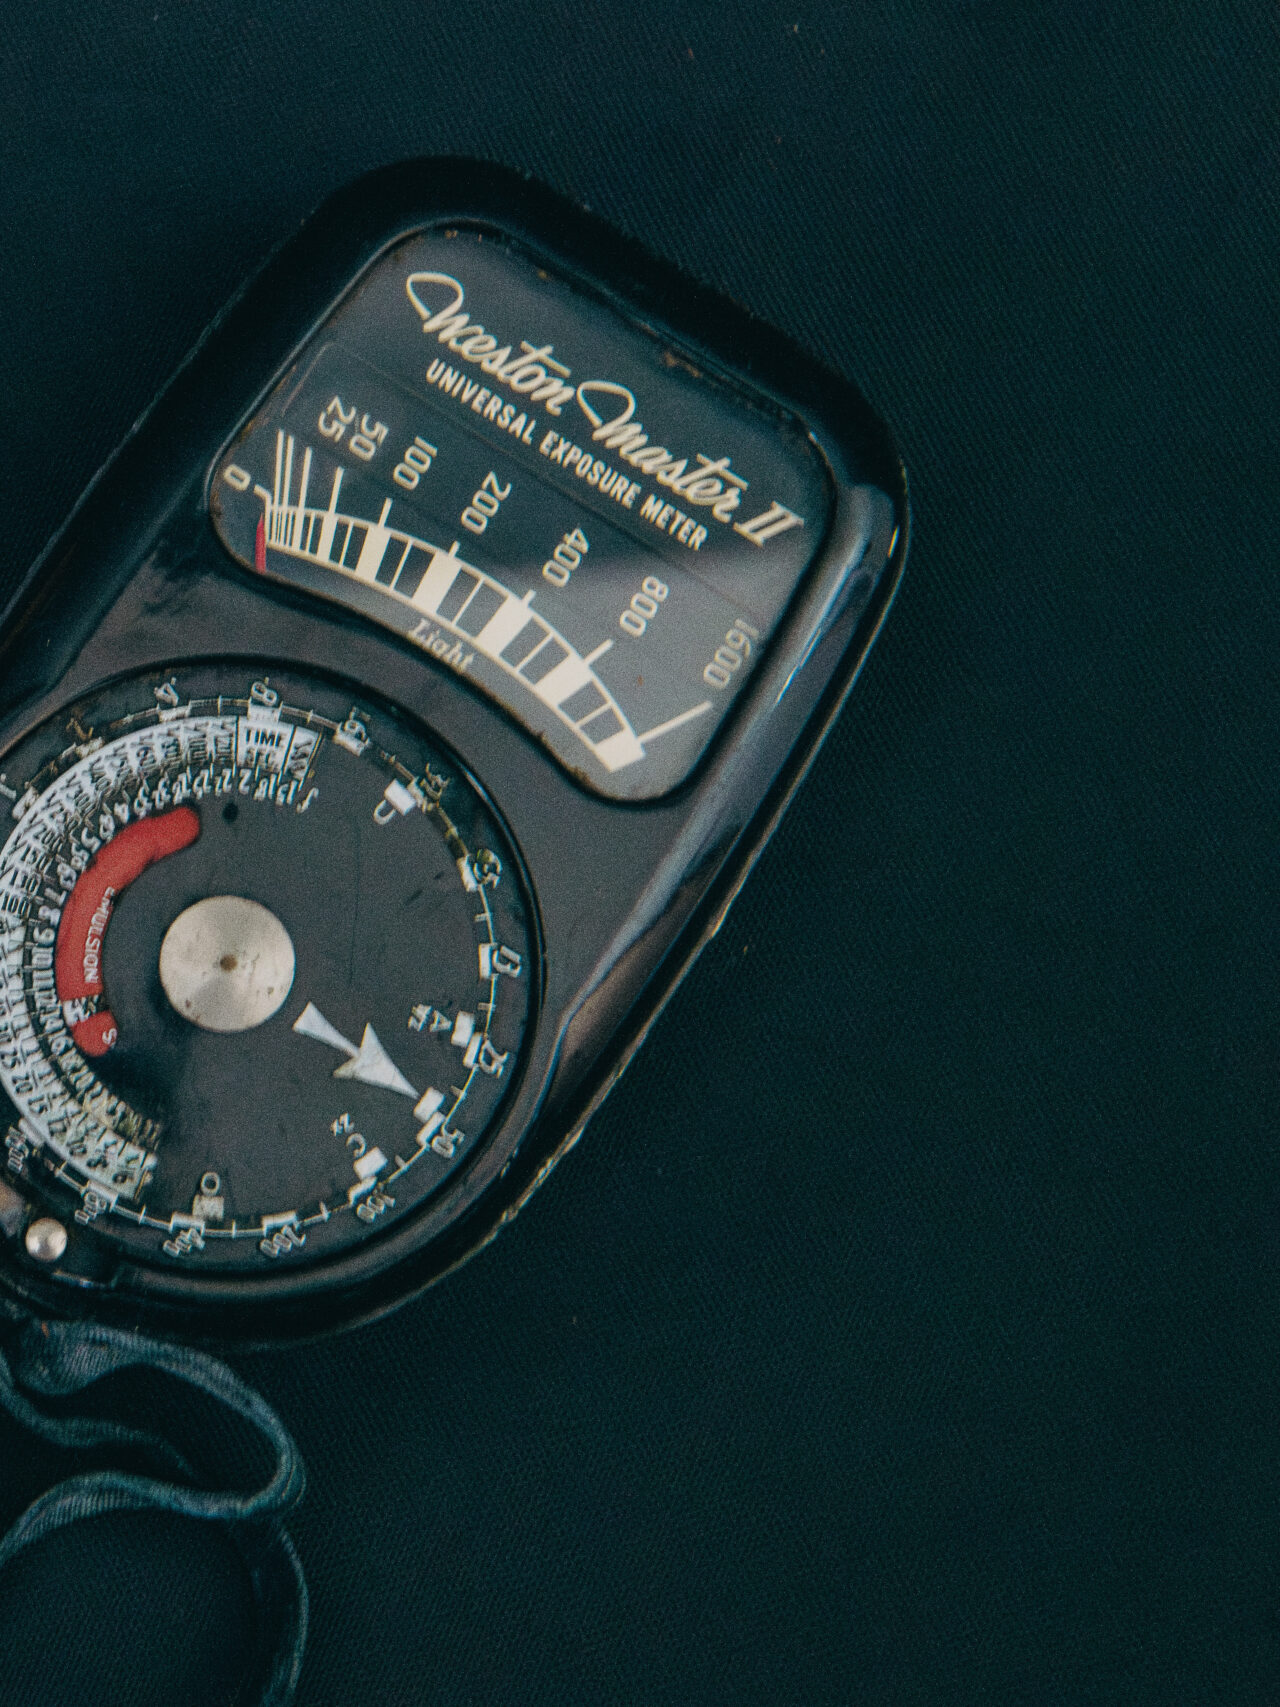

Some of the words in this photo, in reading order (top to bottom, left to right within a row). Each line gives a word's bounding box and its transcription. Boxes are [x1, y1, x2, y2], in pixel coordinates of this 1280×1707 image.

[319, 395, 357, 443] 25
[348, 413, 389, 461] 50
[406, 271, 576, 416] Weston
[577, 379, 749, 524] Master
[733, 501, 805, 548] II
[223, 463, 251, 491] 0
[393, 436, 438, 491] 100
[426, 358, 537, 445] UNIVERSAL
[539, 429, 642, 510] EXPOSURE
[640, 494, 709, 551] METER
[461, 471, 512, 535] 200
[542, 527, 590, 588] 400
[619, 575, 669, 638] 800
[407, 617, 475, 671] Light
[703, 618, 761, 690] 1600
[430, 1010, 452, 1033] A
[479, 1039, 510, 1079] 25
